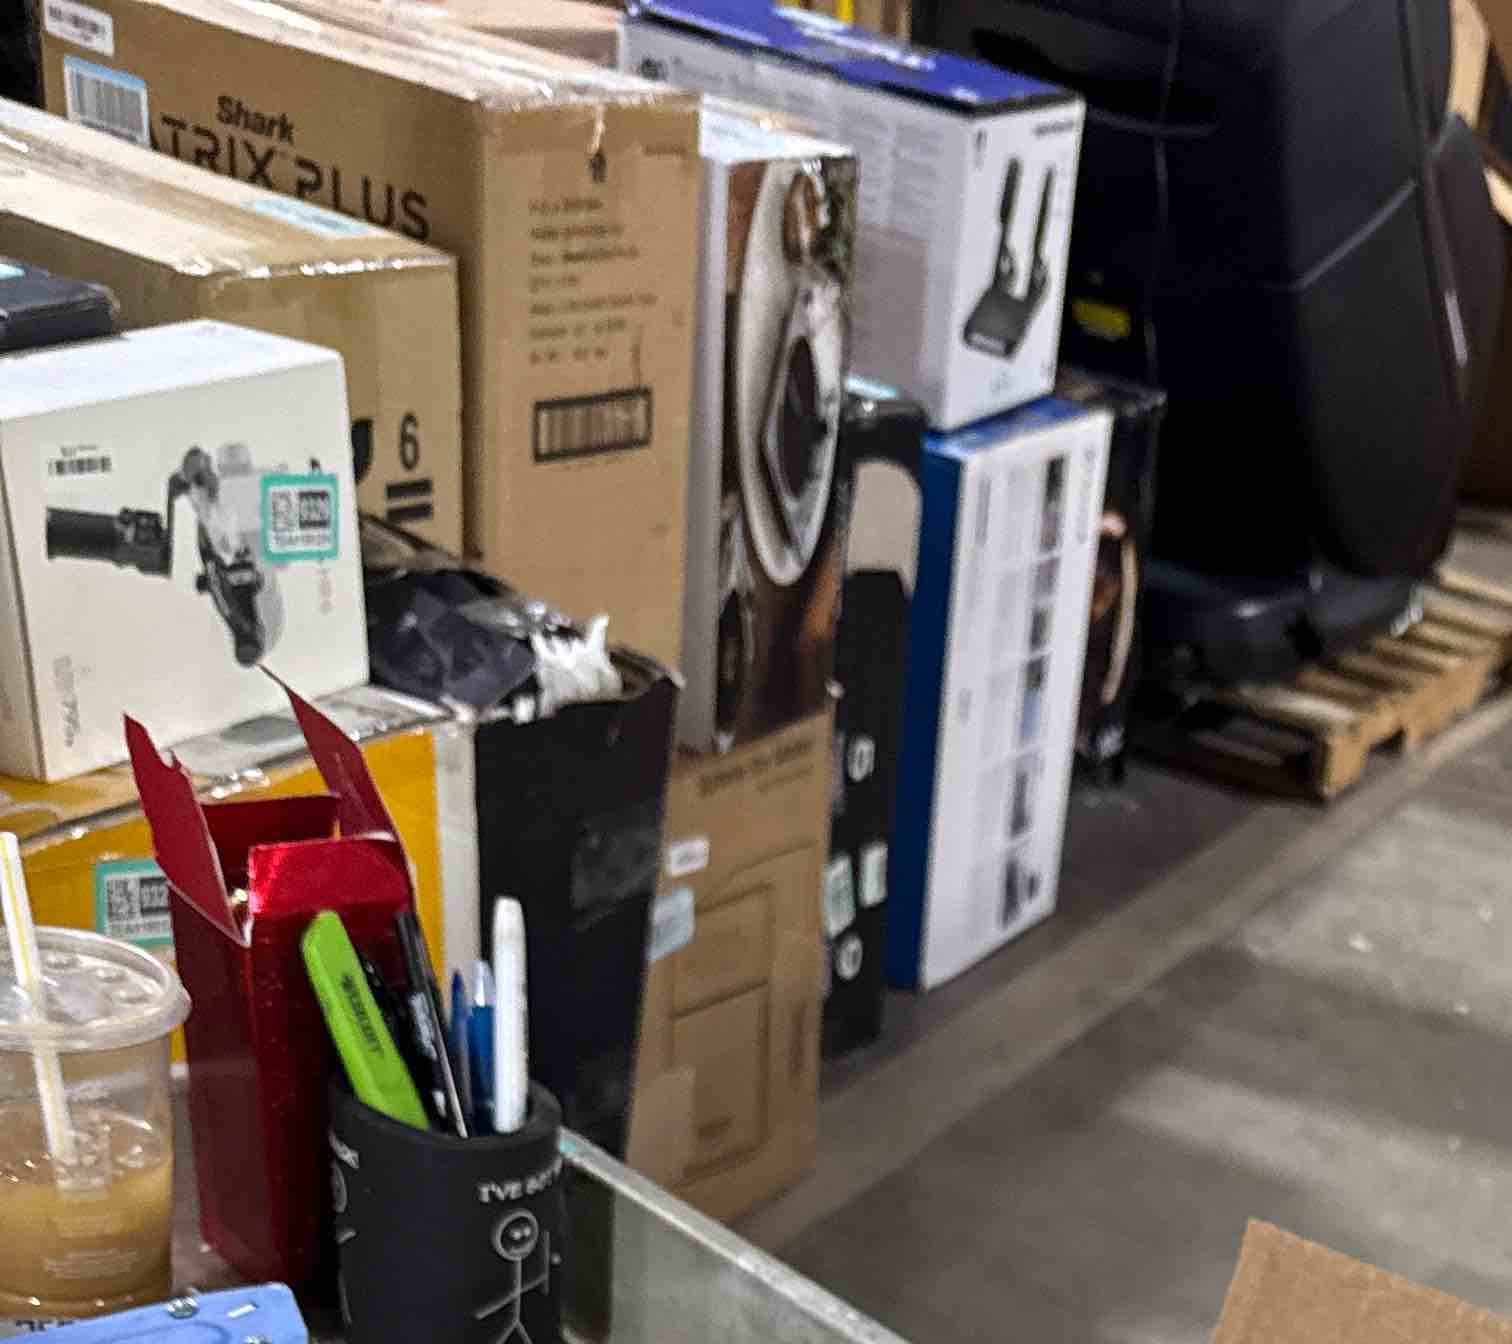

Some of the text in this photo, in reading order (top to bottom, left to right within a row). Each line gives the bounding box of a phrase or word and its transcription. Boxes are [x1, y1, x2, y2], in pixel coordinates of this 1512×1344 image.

[217, 95, 294, 146] Shark
[150, 112, 430, 241] TRIX PLUS
[401, 414, 420, 470] 6
